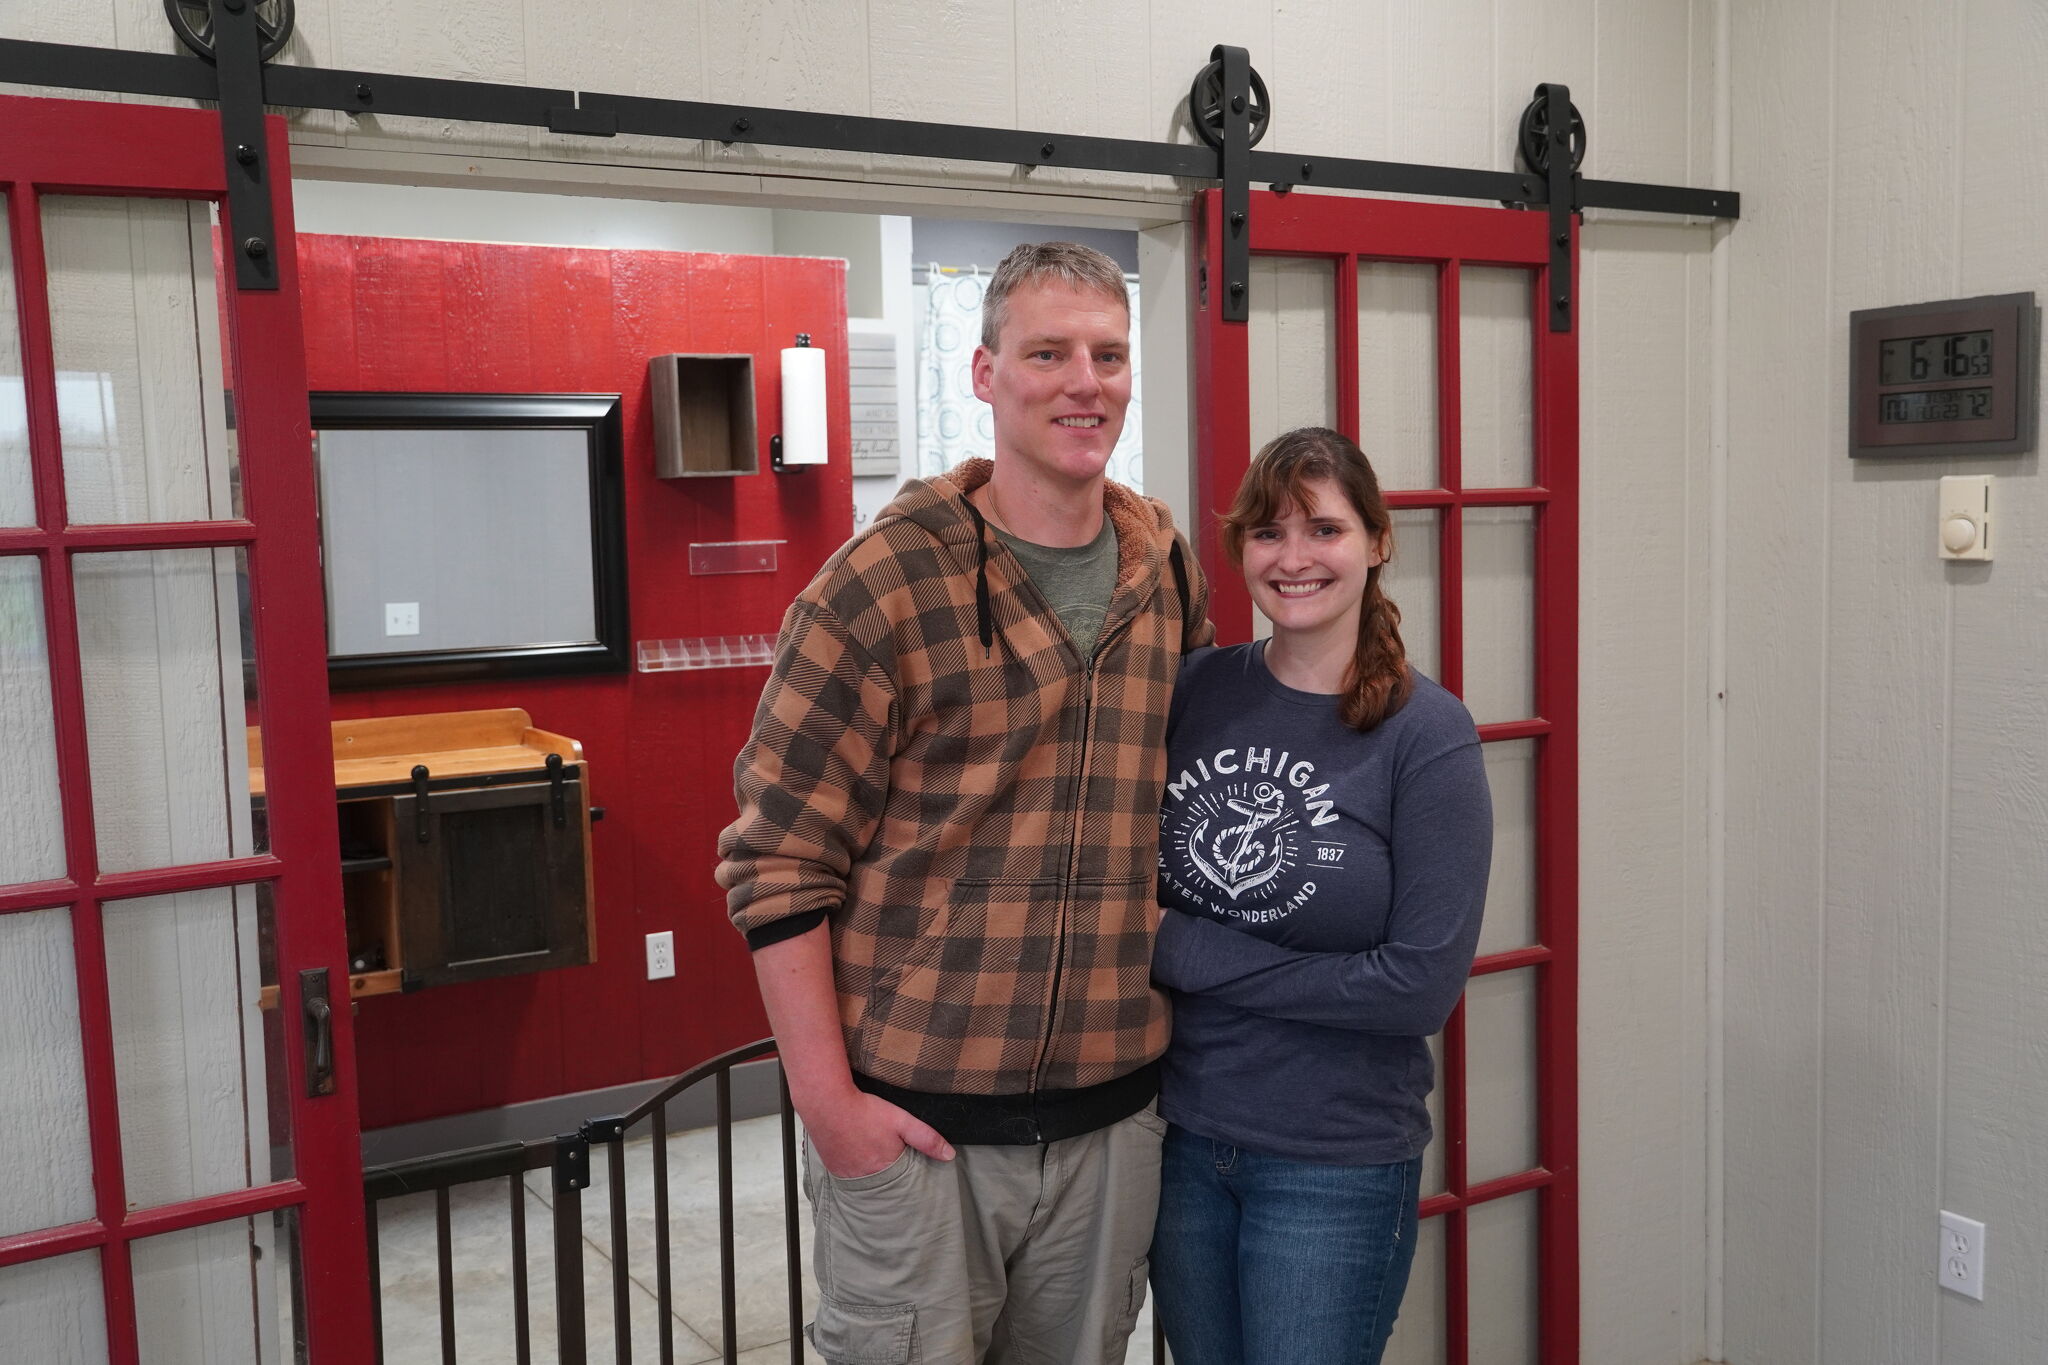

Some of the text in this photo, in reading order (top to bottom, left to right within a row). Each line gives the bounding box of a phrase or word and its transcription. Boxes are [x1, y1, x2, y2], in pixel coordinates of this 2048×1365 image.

[1971, 354, 1990, 376] 53
[1943, 403, 1959, 419] 23
[1966, 393, 1988, 417] 72
[1167, 746, 1340, 827] MICHIGAN
[1317, 847, 1344, 862] 1837
[1210, 881, 1317, 923] WONDERLAND
